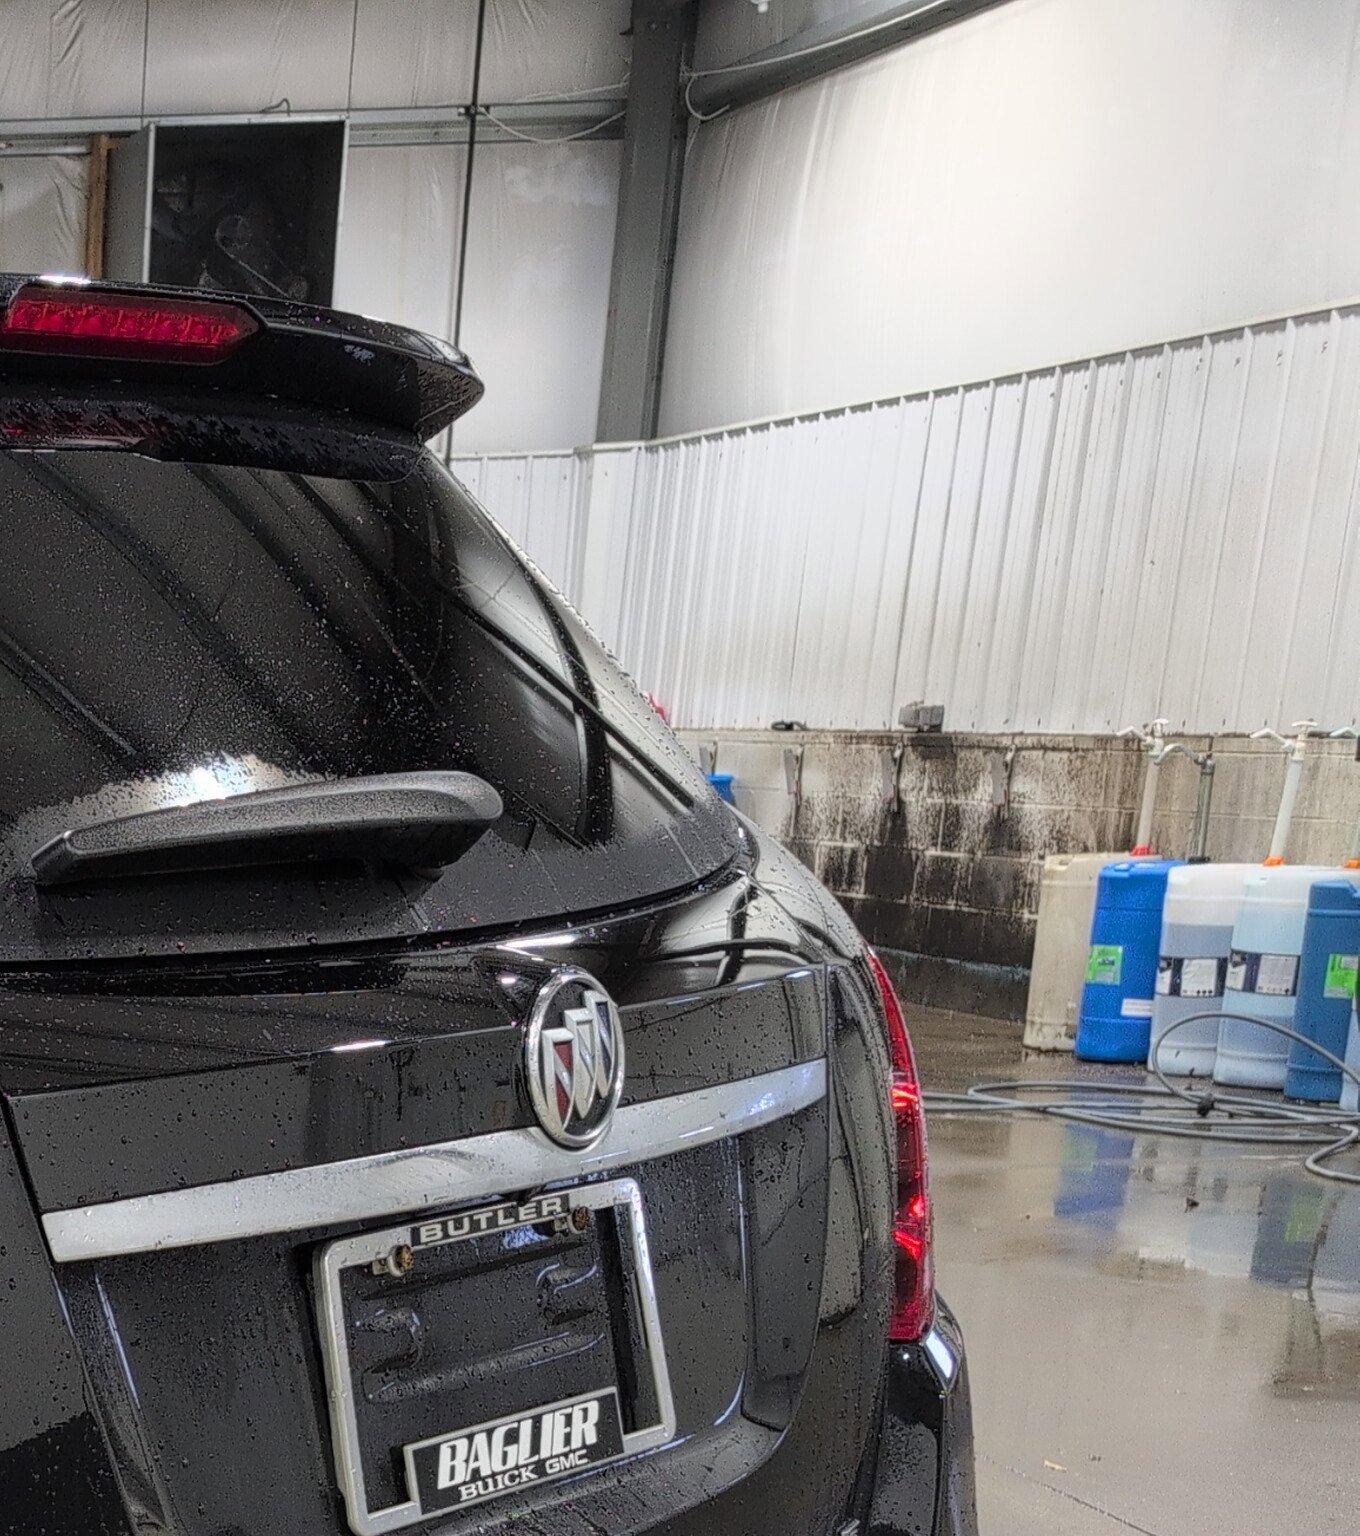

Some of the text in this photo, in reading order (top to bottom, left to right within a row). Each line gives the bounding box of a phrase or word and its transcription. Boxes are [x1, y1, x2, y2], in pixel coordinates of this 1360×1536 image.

[418, 1196, 566, 1244] BUTLER
[436, 1399, 599, 1491] BAGLIER
[458, 1448, 589, 1502] BUICK GMC
